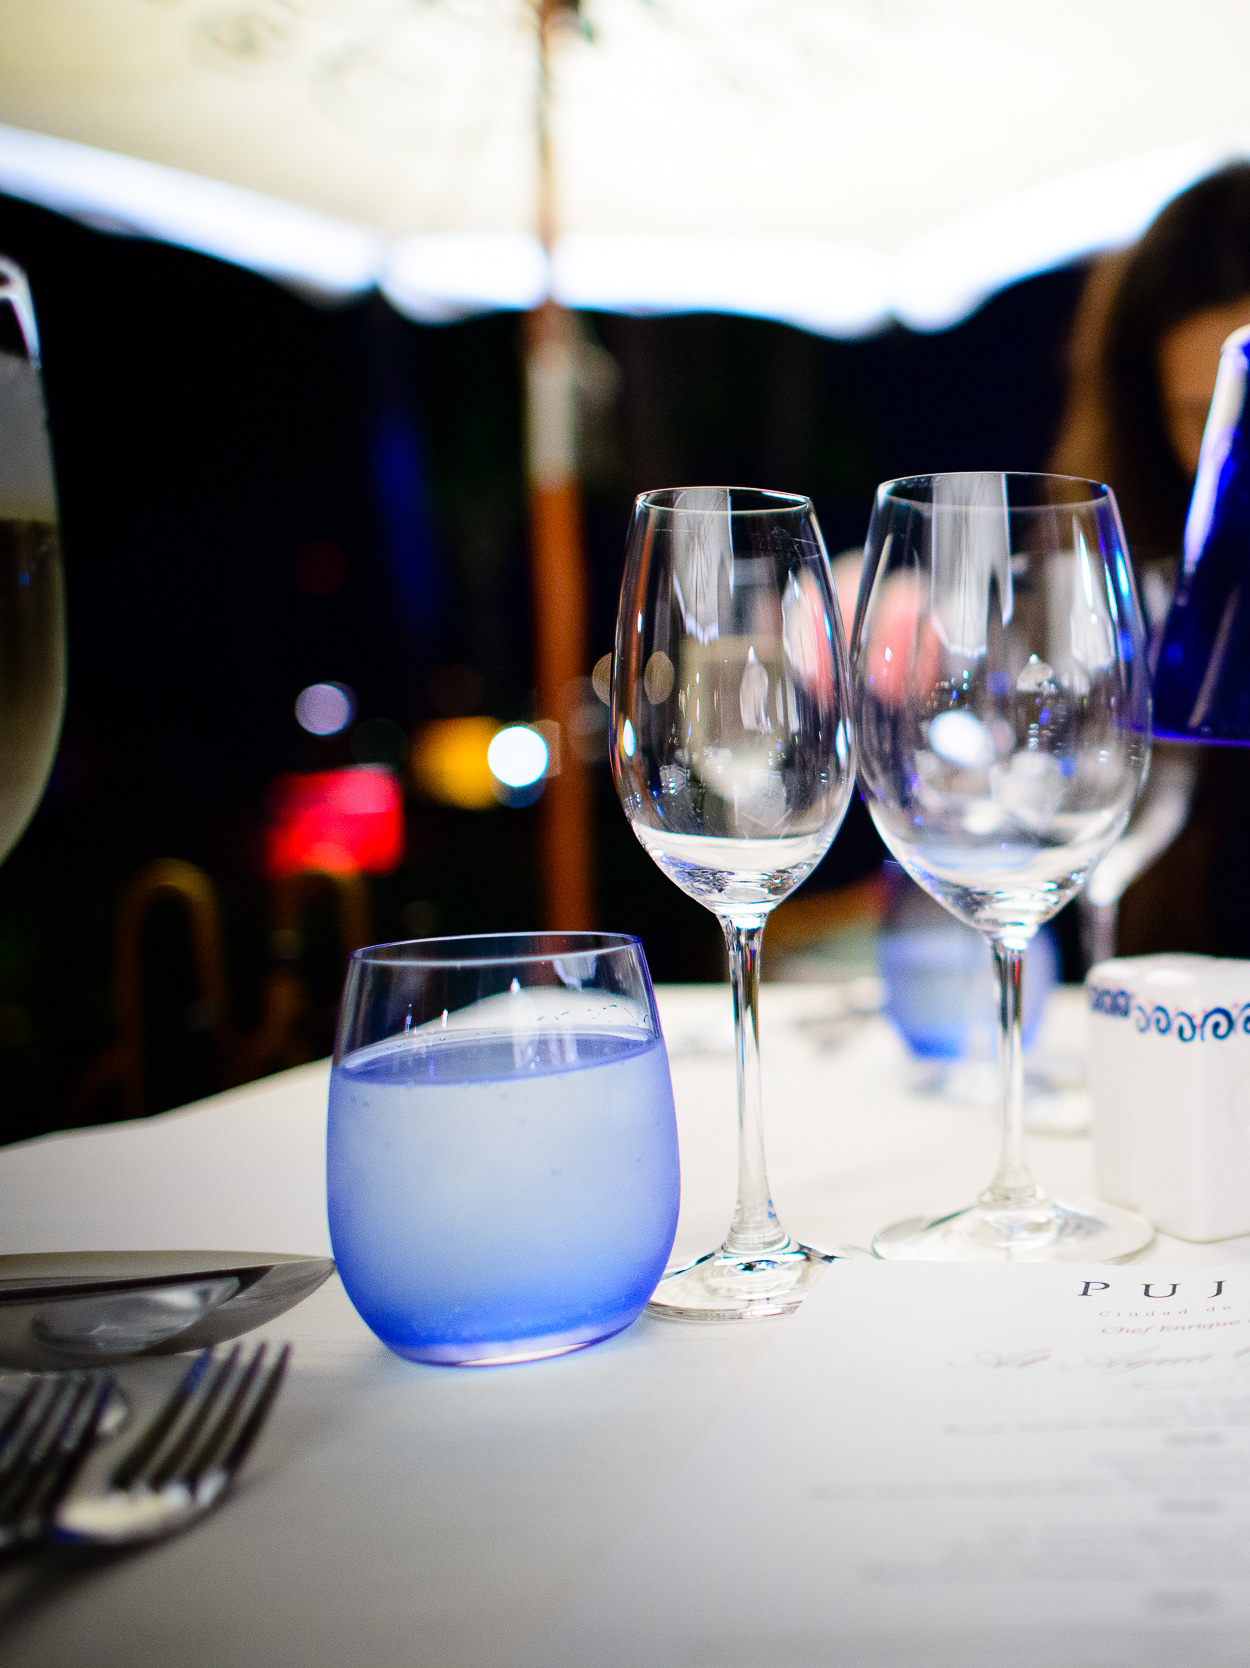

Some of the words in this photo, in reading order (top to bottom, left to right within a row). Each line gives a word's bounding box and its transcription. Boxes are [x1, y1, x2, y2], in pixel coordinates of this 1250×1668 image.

[1099, 1308, 1188, 1317] Ciudad
[1102, 1325, 1156, 1335] Chef
[1159, 1319, 1241, 1332] Enrique
